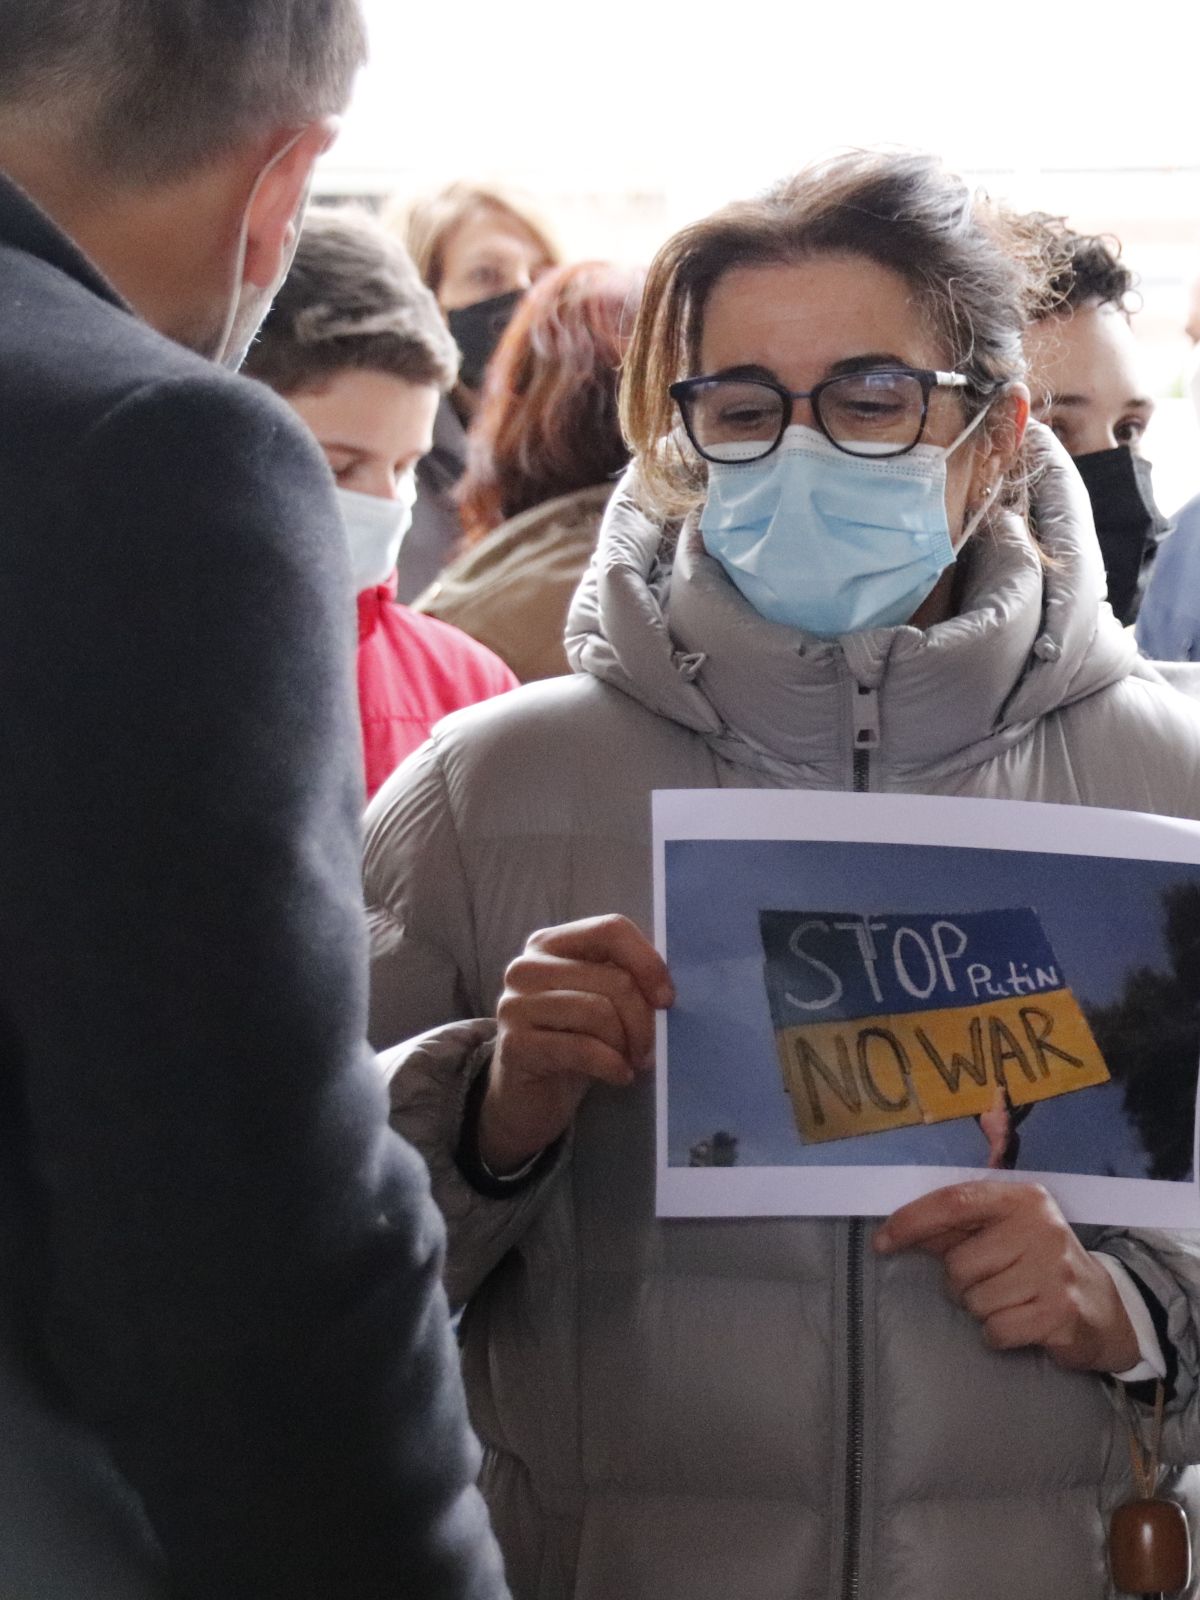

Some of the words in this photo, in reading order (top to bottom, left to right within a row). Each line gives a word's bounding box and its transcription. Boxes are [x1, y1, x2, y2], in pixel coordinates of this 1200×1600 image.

[785, 920, 968, 1010] STOP
[793, 1026, 911, 1126] NO
[914, 1007, 1084, 1093] WAR
